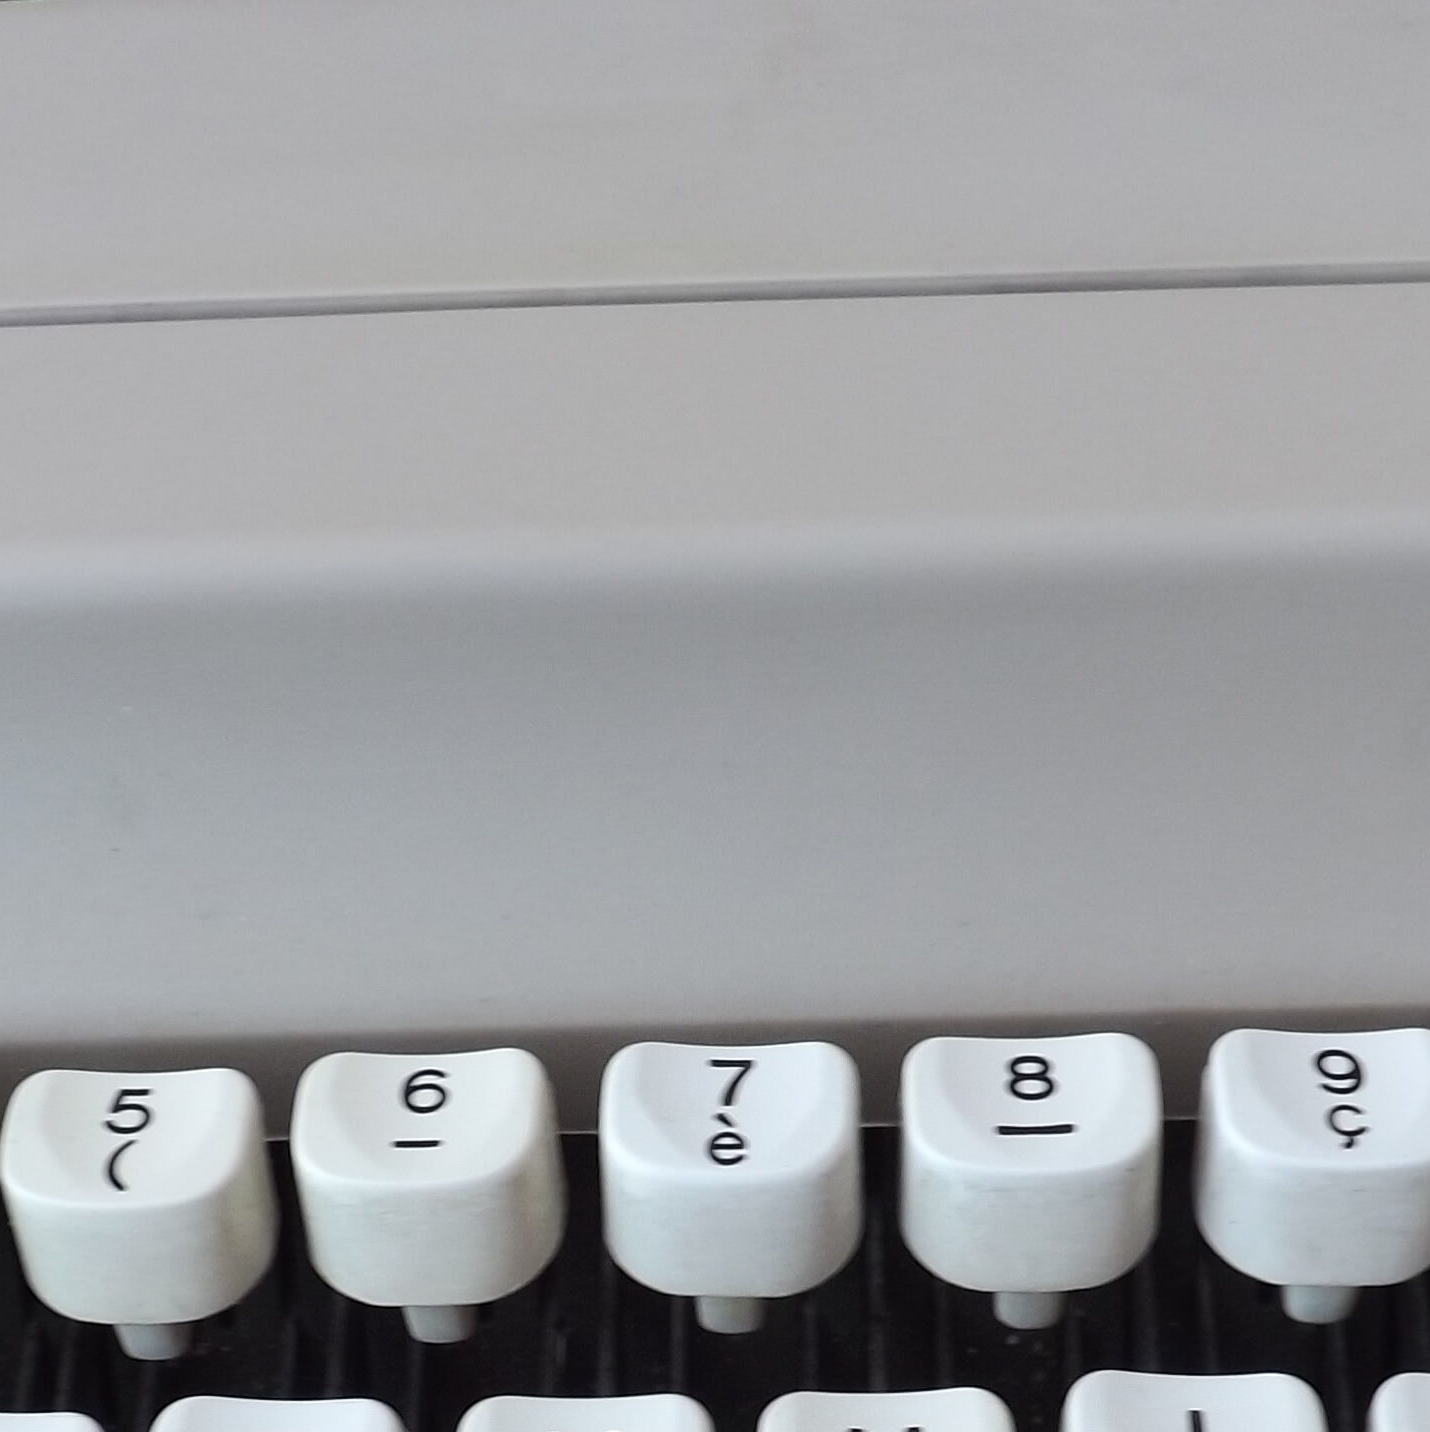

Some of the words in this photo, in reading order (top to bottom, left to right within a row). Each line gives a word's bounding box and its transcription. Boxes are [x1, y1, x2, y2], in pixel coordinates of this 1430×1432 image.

[401, 1067, 449, 1116] 6
[708, 1058, 754, 1108] 7
[1006, 1054, 1057, 1102] 8
[1312, 1048, 1365, 1096] 9
[103, 1087, 153, 1136] 5
[1326, 1103, 1369, 1151] ç
[706, 1112, 749, 1167] è
[105, 1138, 137, 1193] (
